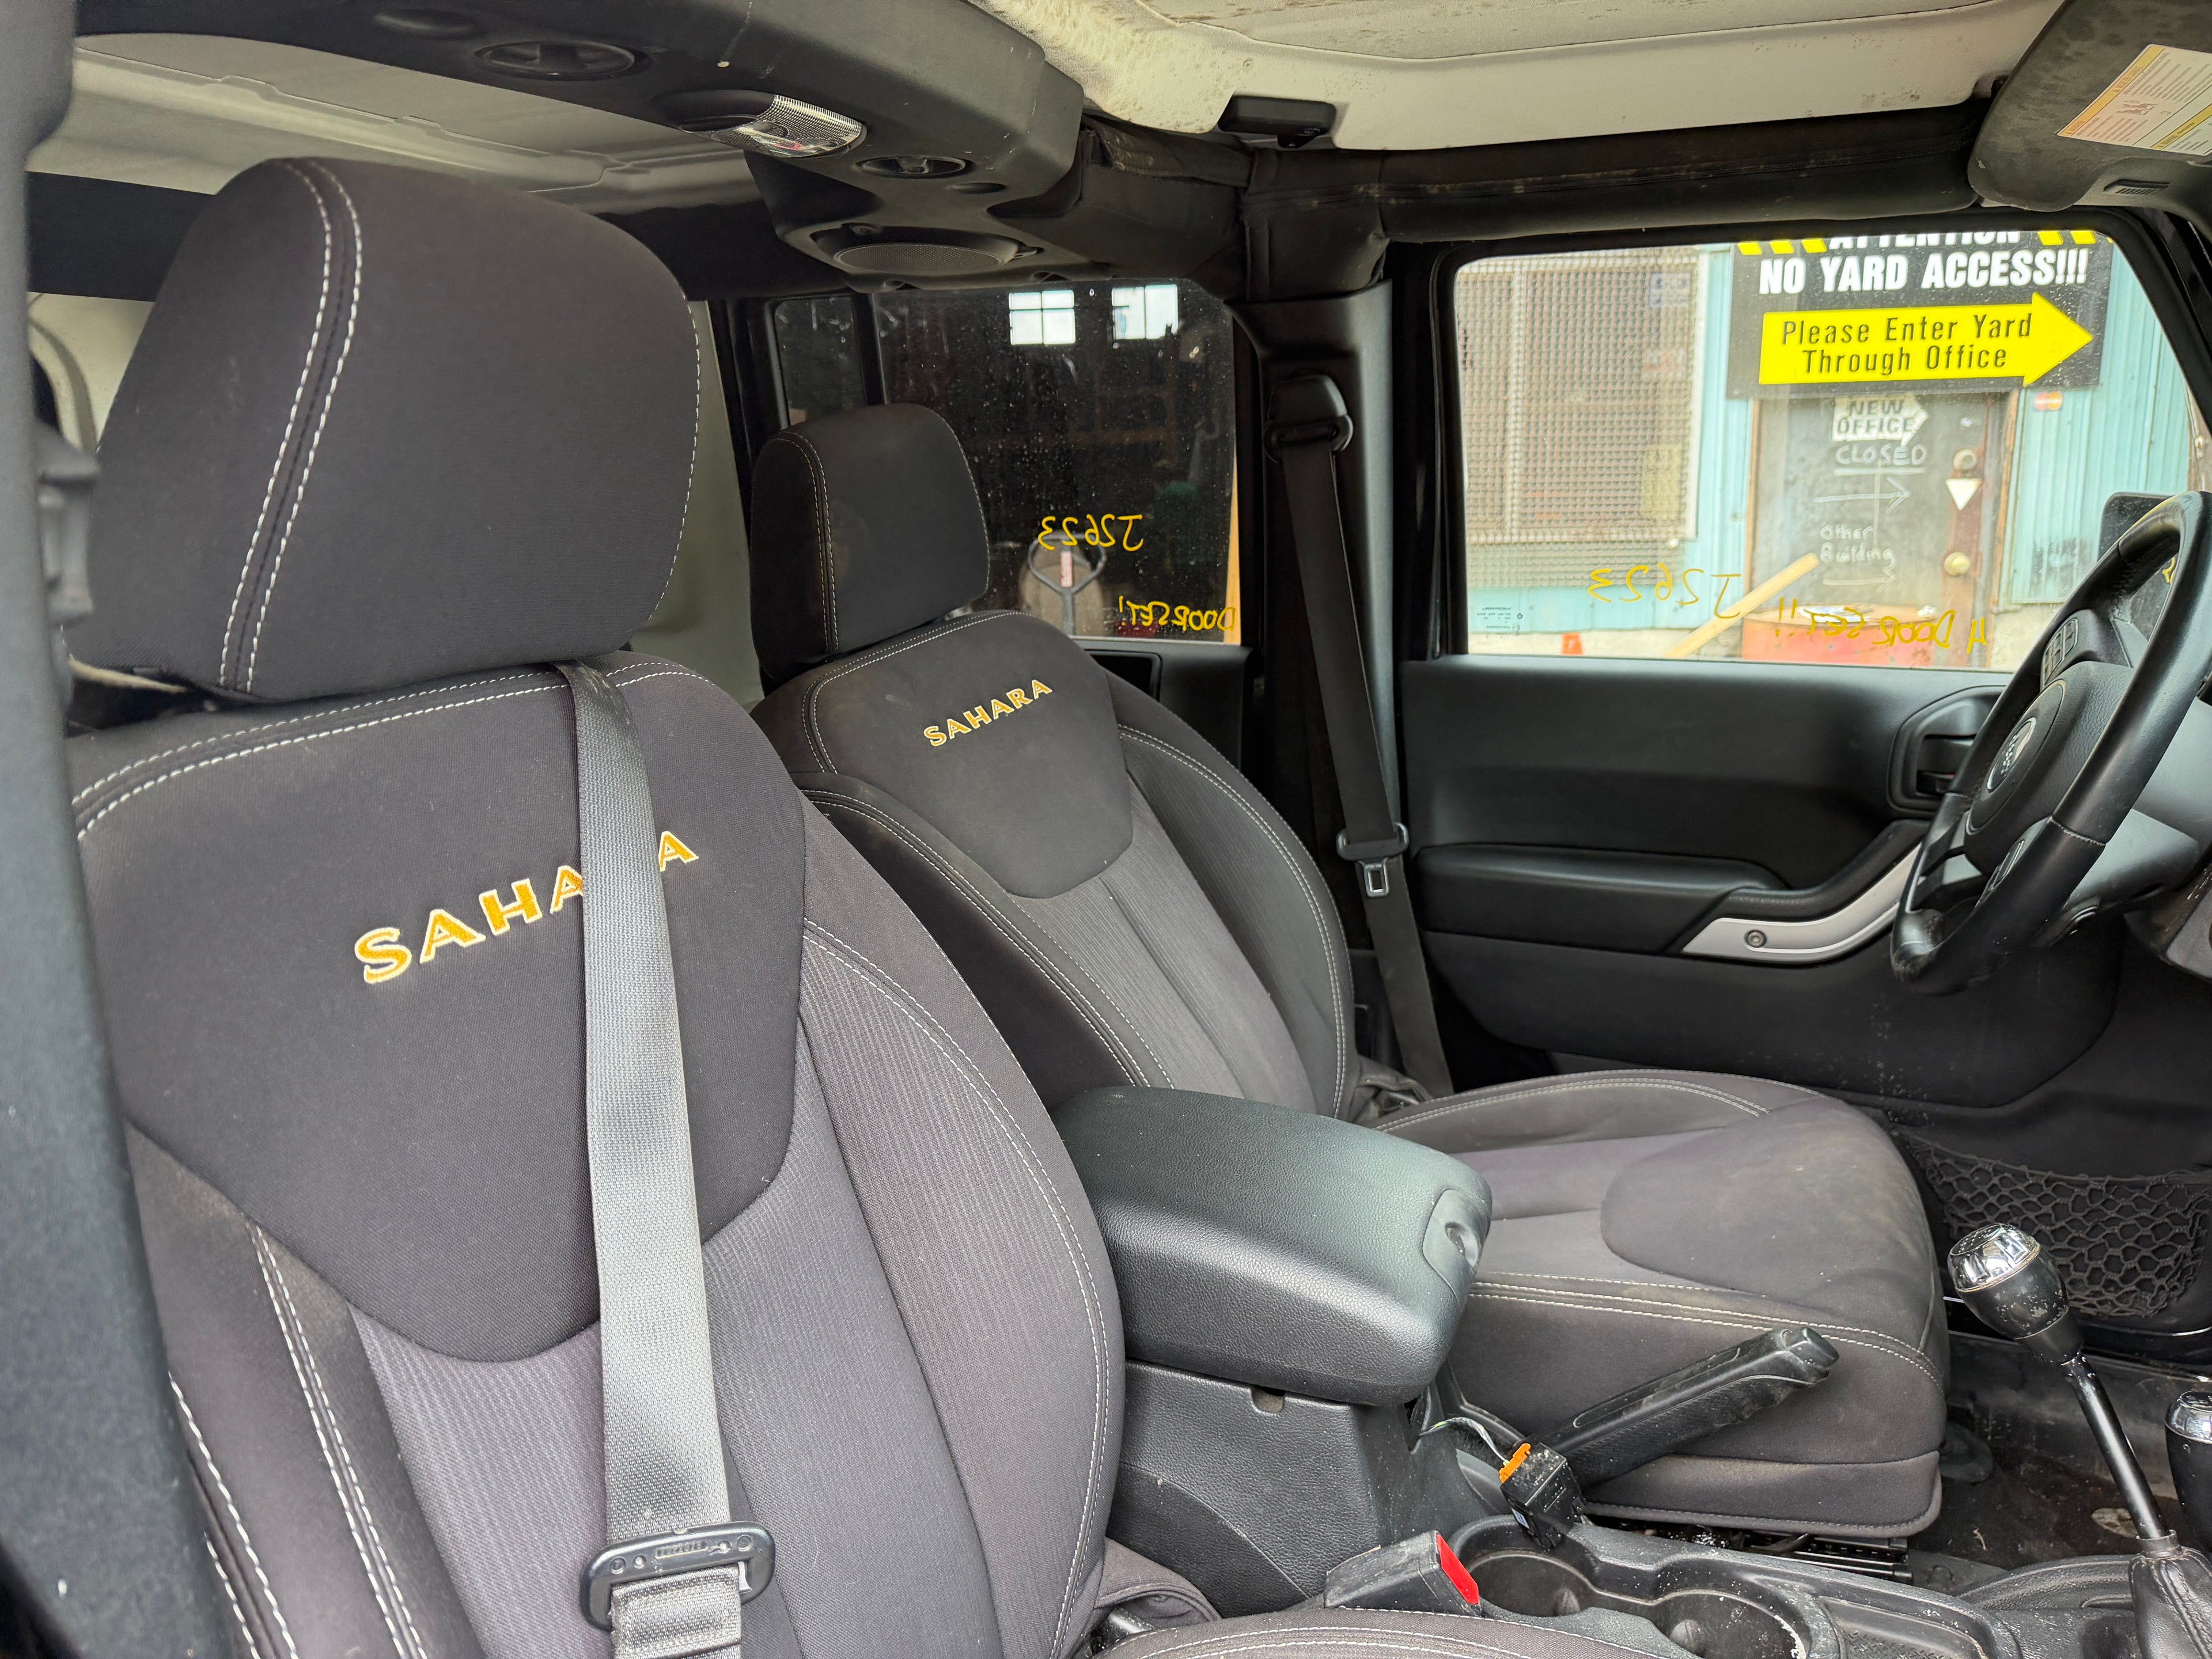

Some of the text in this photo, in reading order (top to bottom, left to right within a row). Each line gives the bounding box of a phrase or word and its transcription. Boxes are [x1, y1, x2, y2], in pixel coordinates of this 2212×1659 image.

[1759, 248, 2089, 294] NO YARD ACCESS!!!
[1781, 313, 2032, 346] Please Enter Yard
[1801, 344, 2008, 376] Through Office
[1837, 416, 1915, 435] OFFICE
[1835, 442, 1927, 466] CLOSED
[923, 679, 1053, 747] SAHARA
[354, 831, 699, 984] SAHAA
